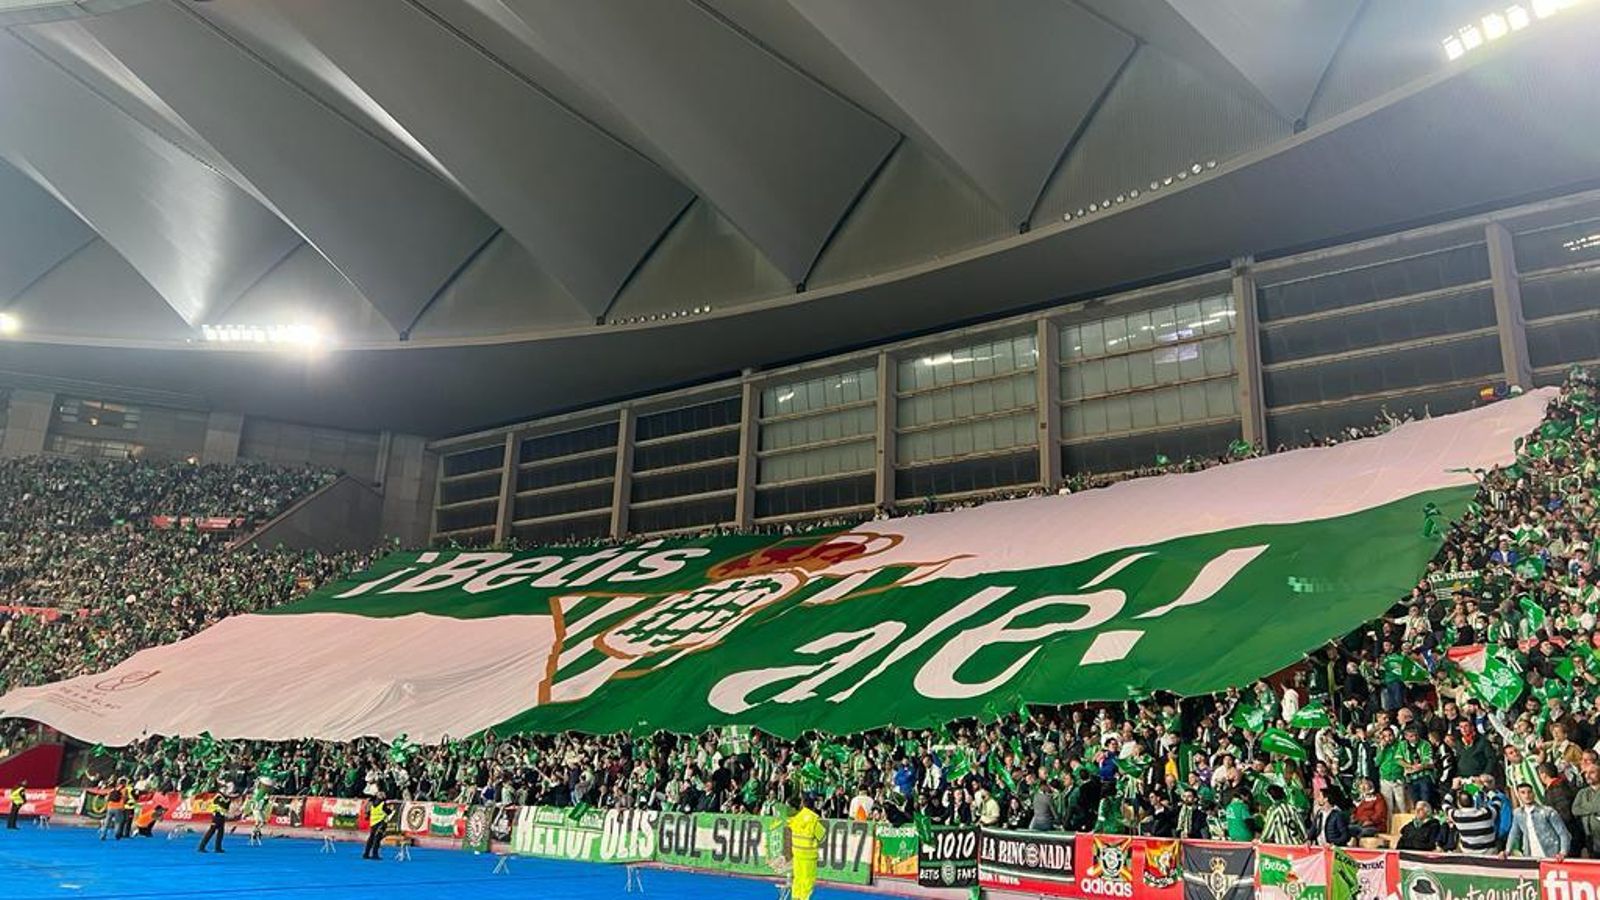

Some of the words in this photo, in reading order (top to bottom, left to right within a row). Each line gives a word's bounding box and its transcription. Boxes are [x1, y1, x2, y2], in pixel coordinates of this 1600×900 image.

[333, 540, 711, 599] ¡Betis
[707, 544, 1270, 715] alé!
[515, 806, 658, 861] HELIOPOLIS
[659, 813, 701, 858] GOL
[712, 818, 762, 865] SUR
[980, 837, 996, 861] LA
[1080, 877, 1134, 898] adidas
